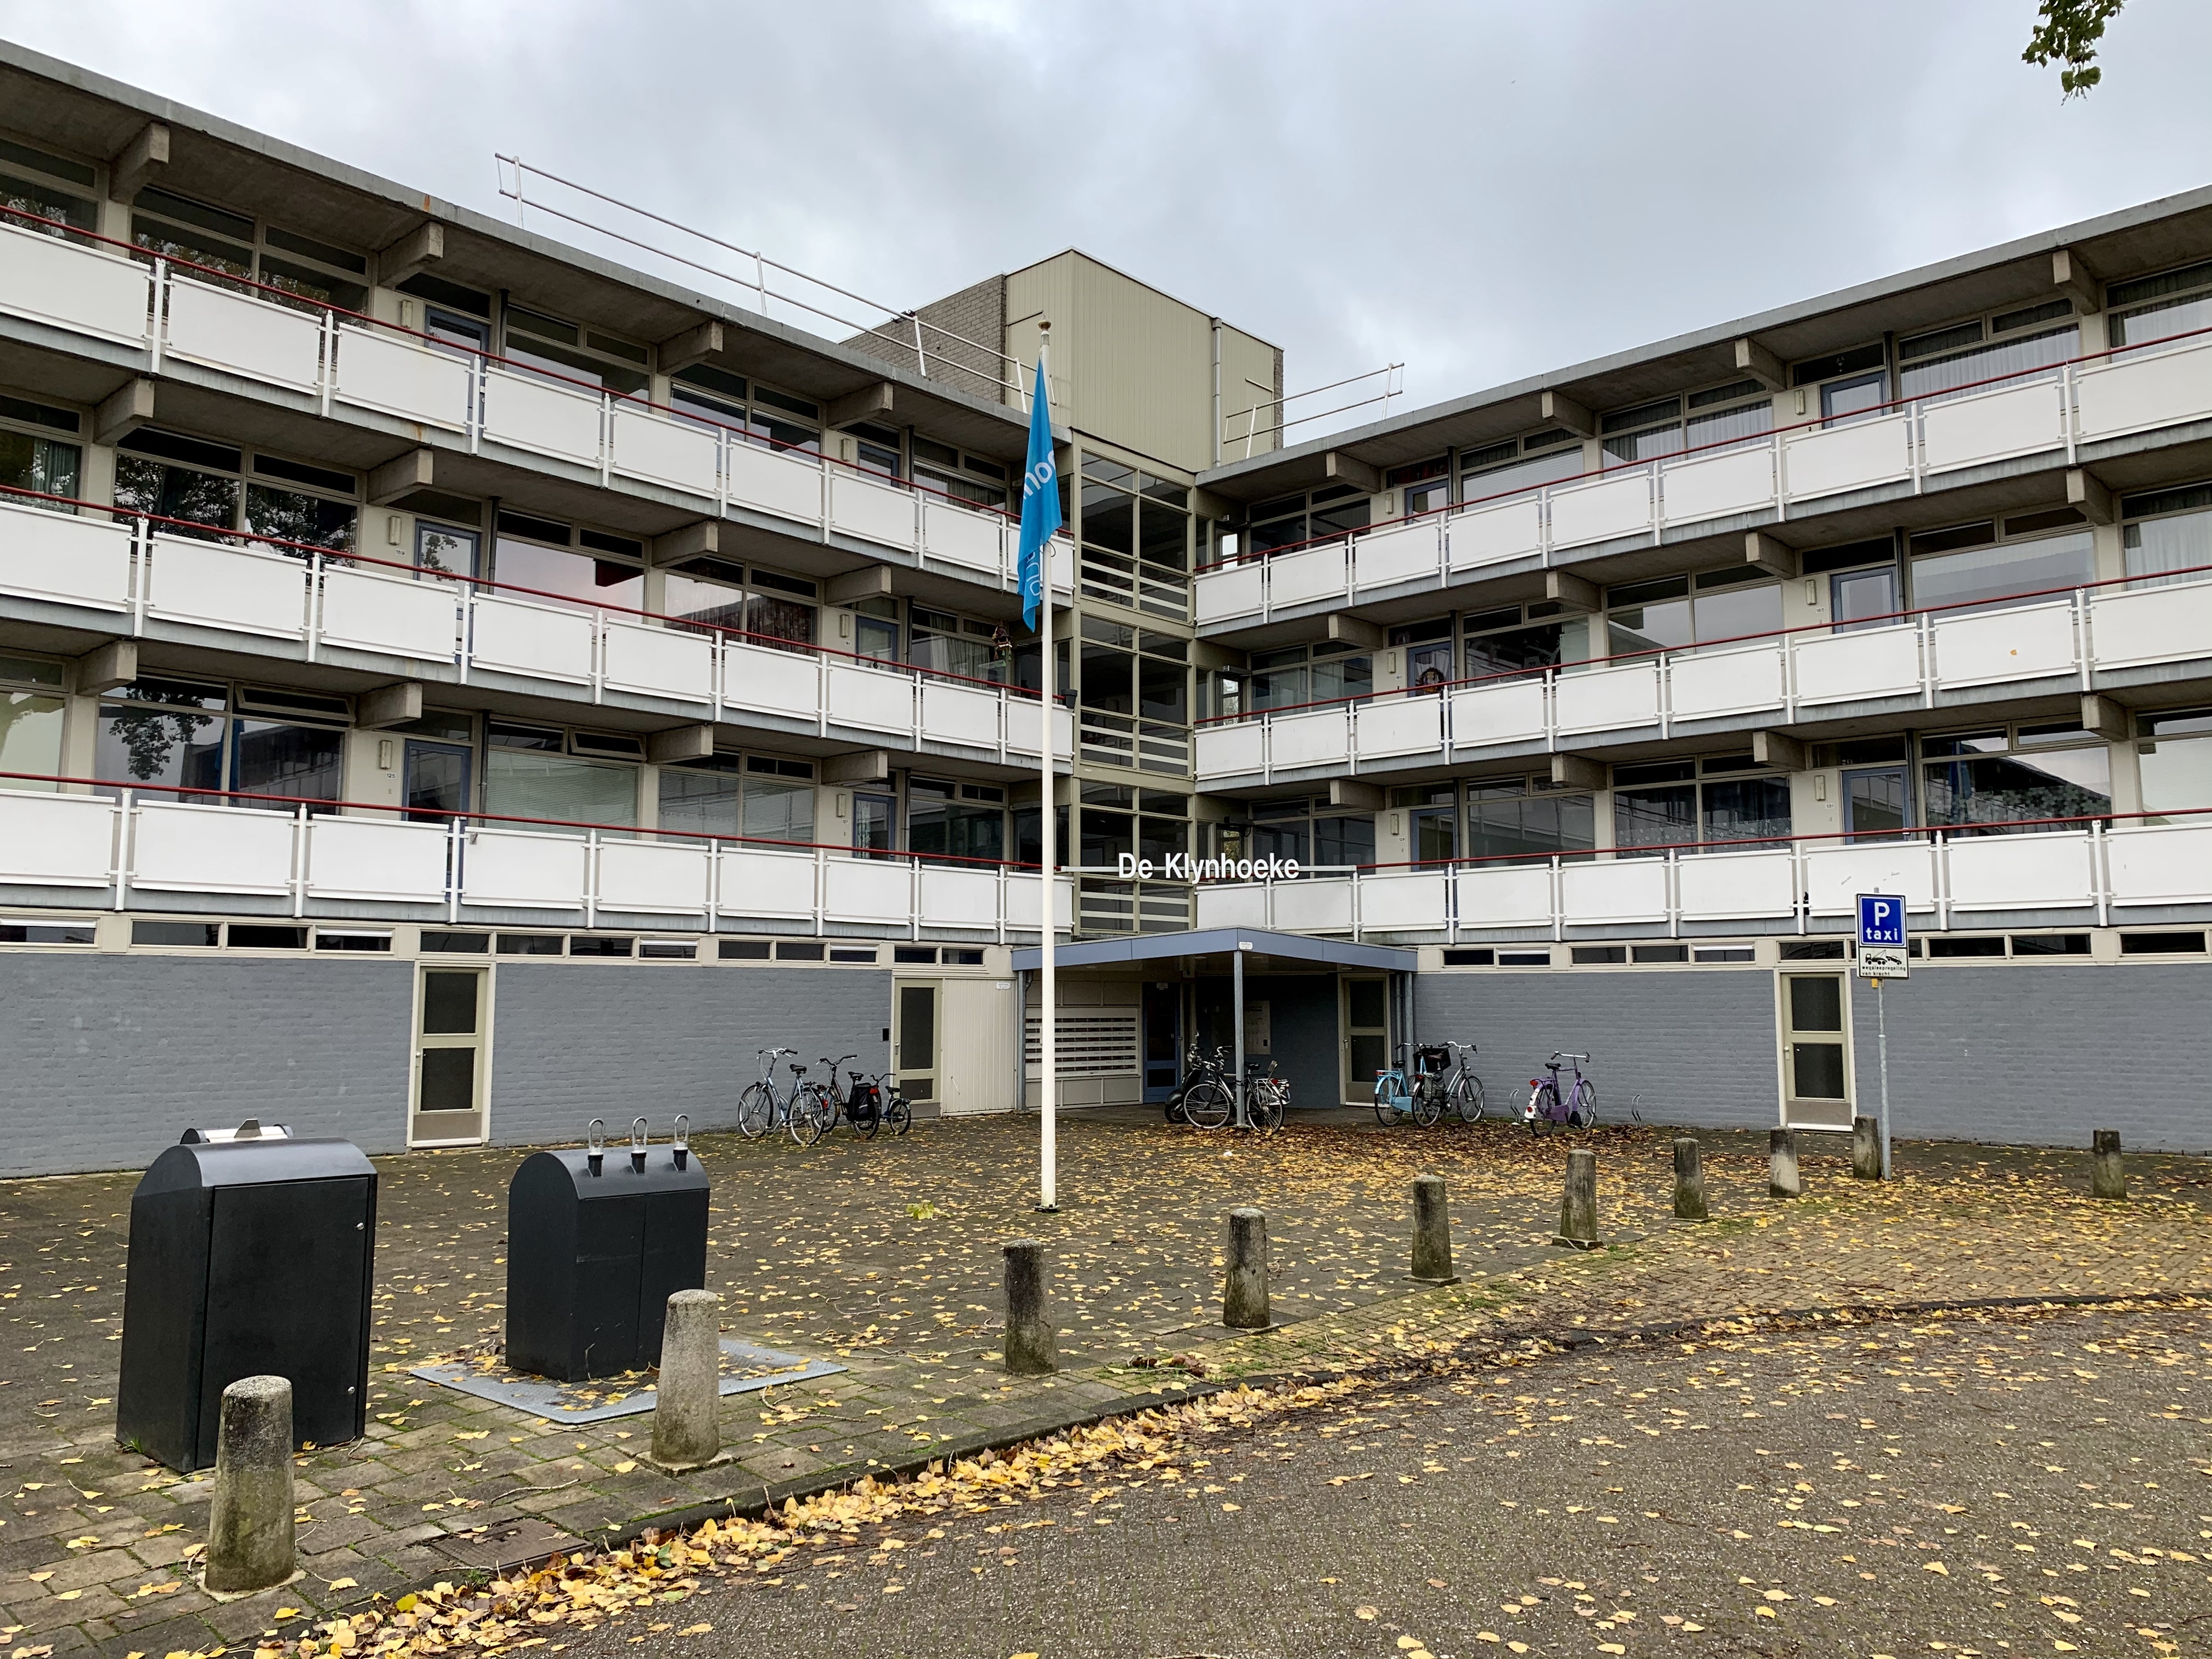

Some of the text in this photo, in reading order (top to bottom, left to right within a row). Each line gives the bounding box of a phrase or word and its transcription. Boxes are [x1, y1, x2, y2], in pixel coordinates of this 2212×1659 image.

[1119, 853, 1299, 884] De Klynhoeke
[1874, 902, 1890, 926] P
[1866, 927, 1898, 940] taxi
